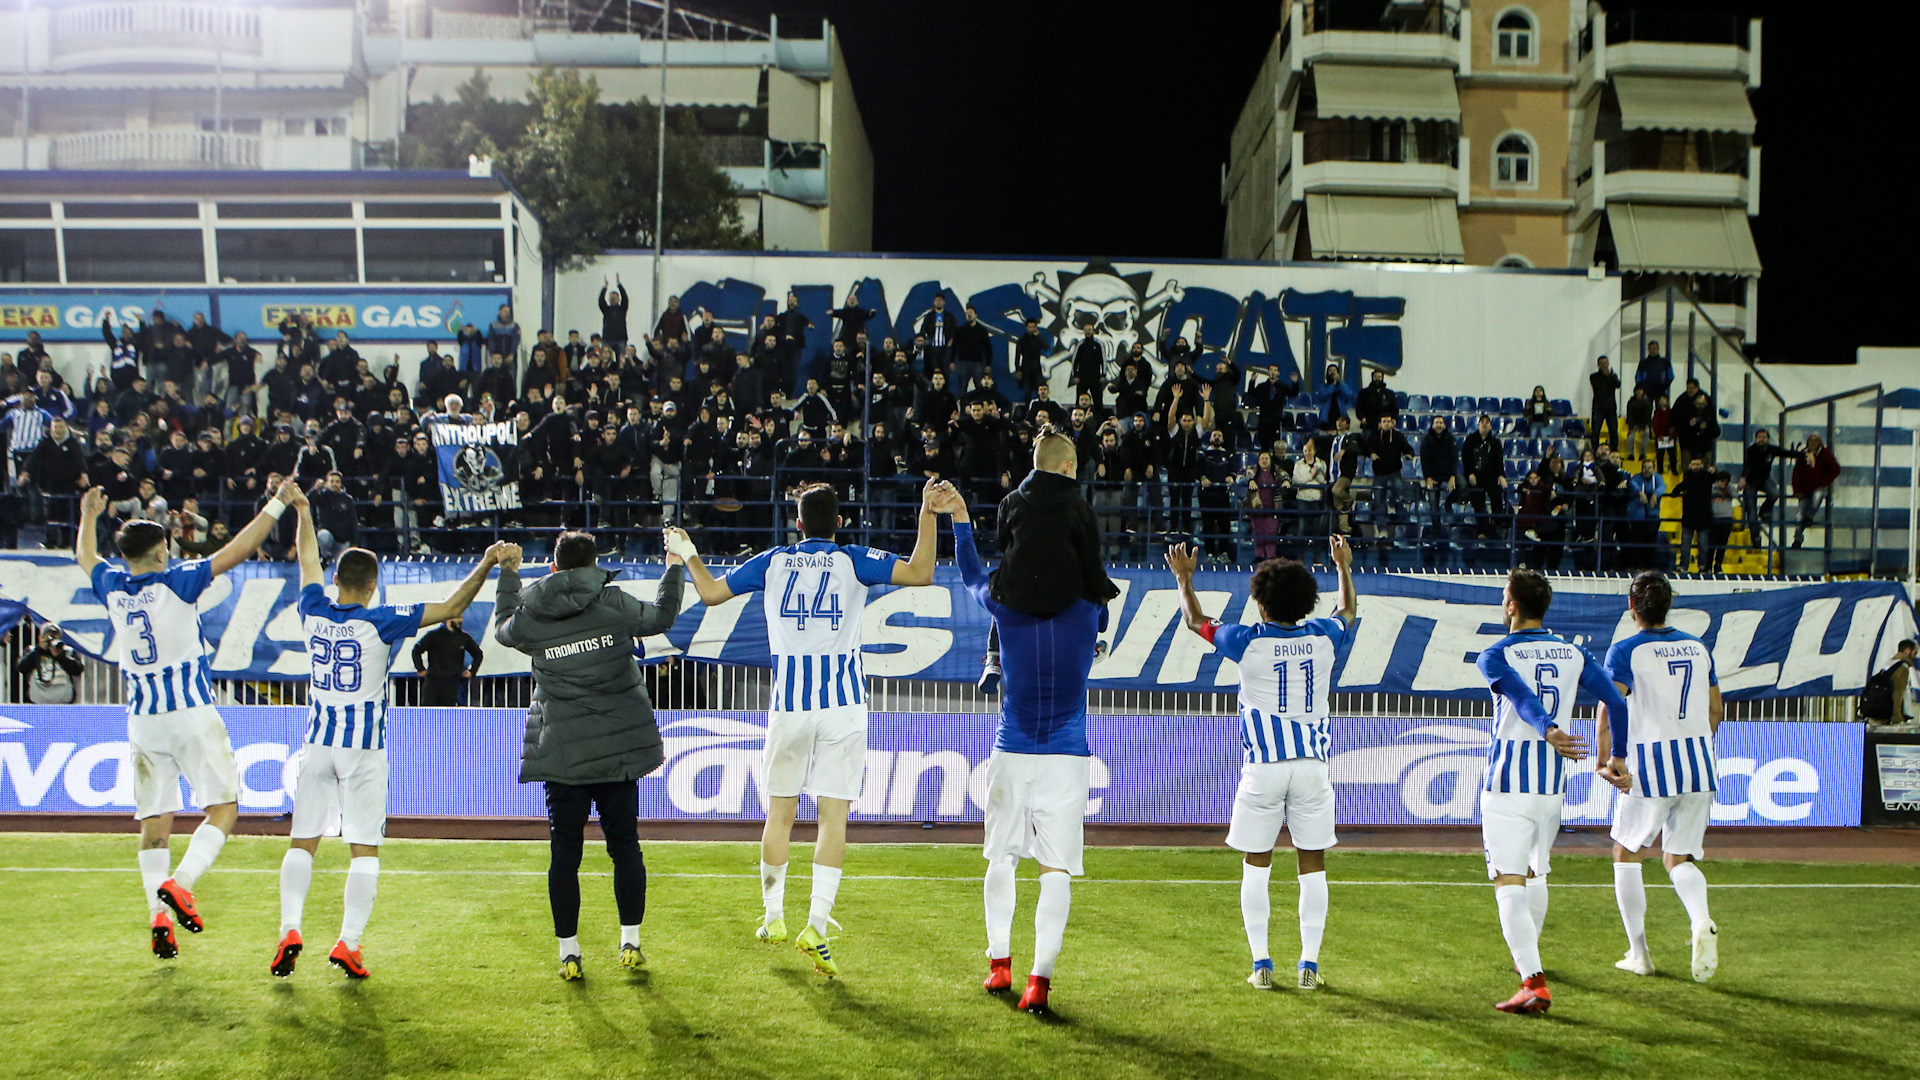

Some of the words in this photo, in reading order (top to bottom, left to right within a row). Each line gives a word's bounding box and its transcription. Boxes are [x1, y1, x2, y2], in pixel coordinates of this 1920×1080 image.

[0, 308, 57, 327] EKA
[65, 305, 145, 329] GAS
[362, 305, 442, 328] GAS
[1157, 286, 1406, 397] GATE
[431, 420, 518, 446] ANTHOUPOLI
[442, 481, 523, 512] EXTREME
[785, 556, 834, 569] RISVANIS
[780, 571, 843, 631] 44
[127, 610, 158, 665] 3
[314, 622, 355, 637] NATSOS
[544, 637, 600, 660] ATROMITOS
[601, 634, 614, 648] FC
[1274, 643, 1313, 657] BRUNO
[1654, 646, 1700, 658] MUJAKIC
[310, 635, 362, 692] 28
[1273, 659, 1314, 713] 11
[1535, 663, 1560, 721] 6
[1667, 660, 1693, 720] 7
